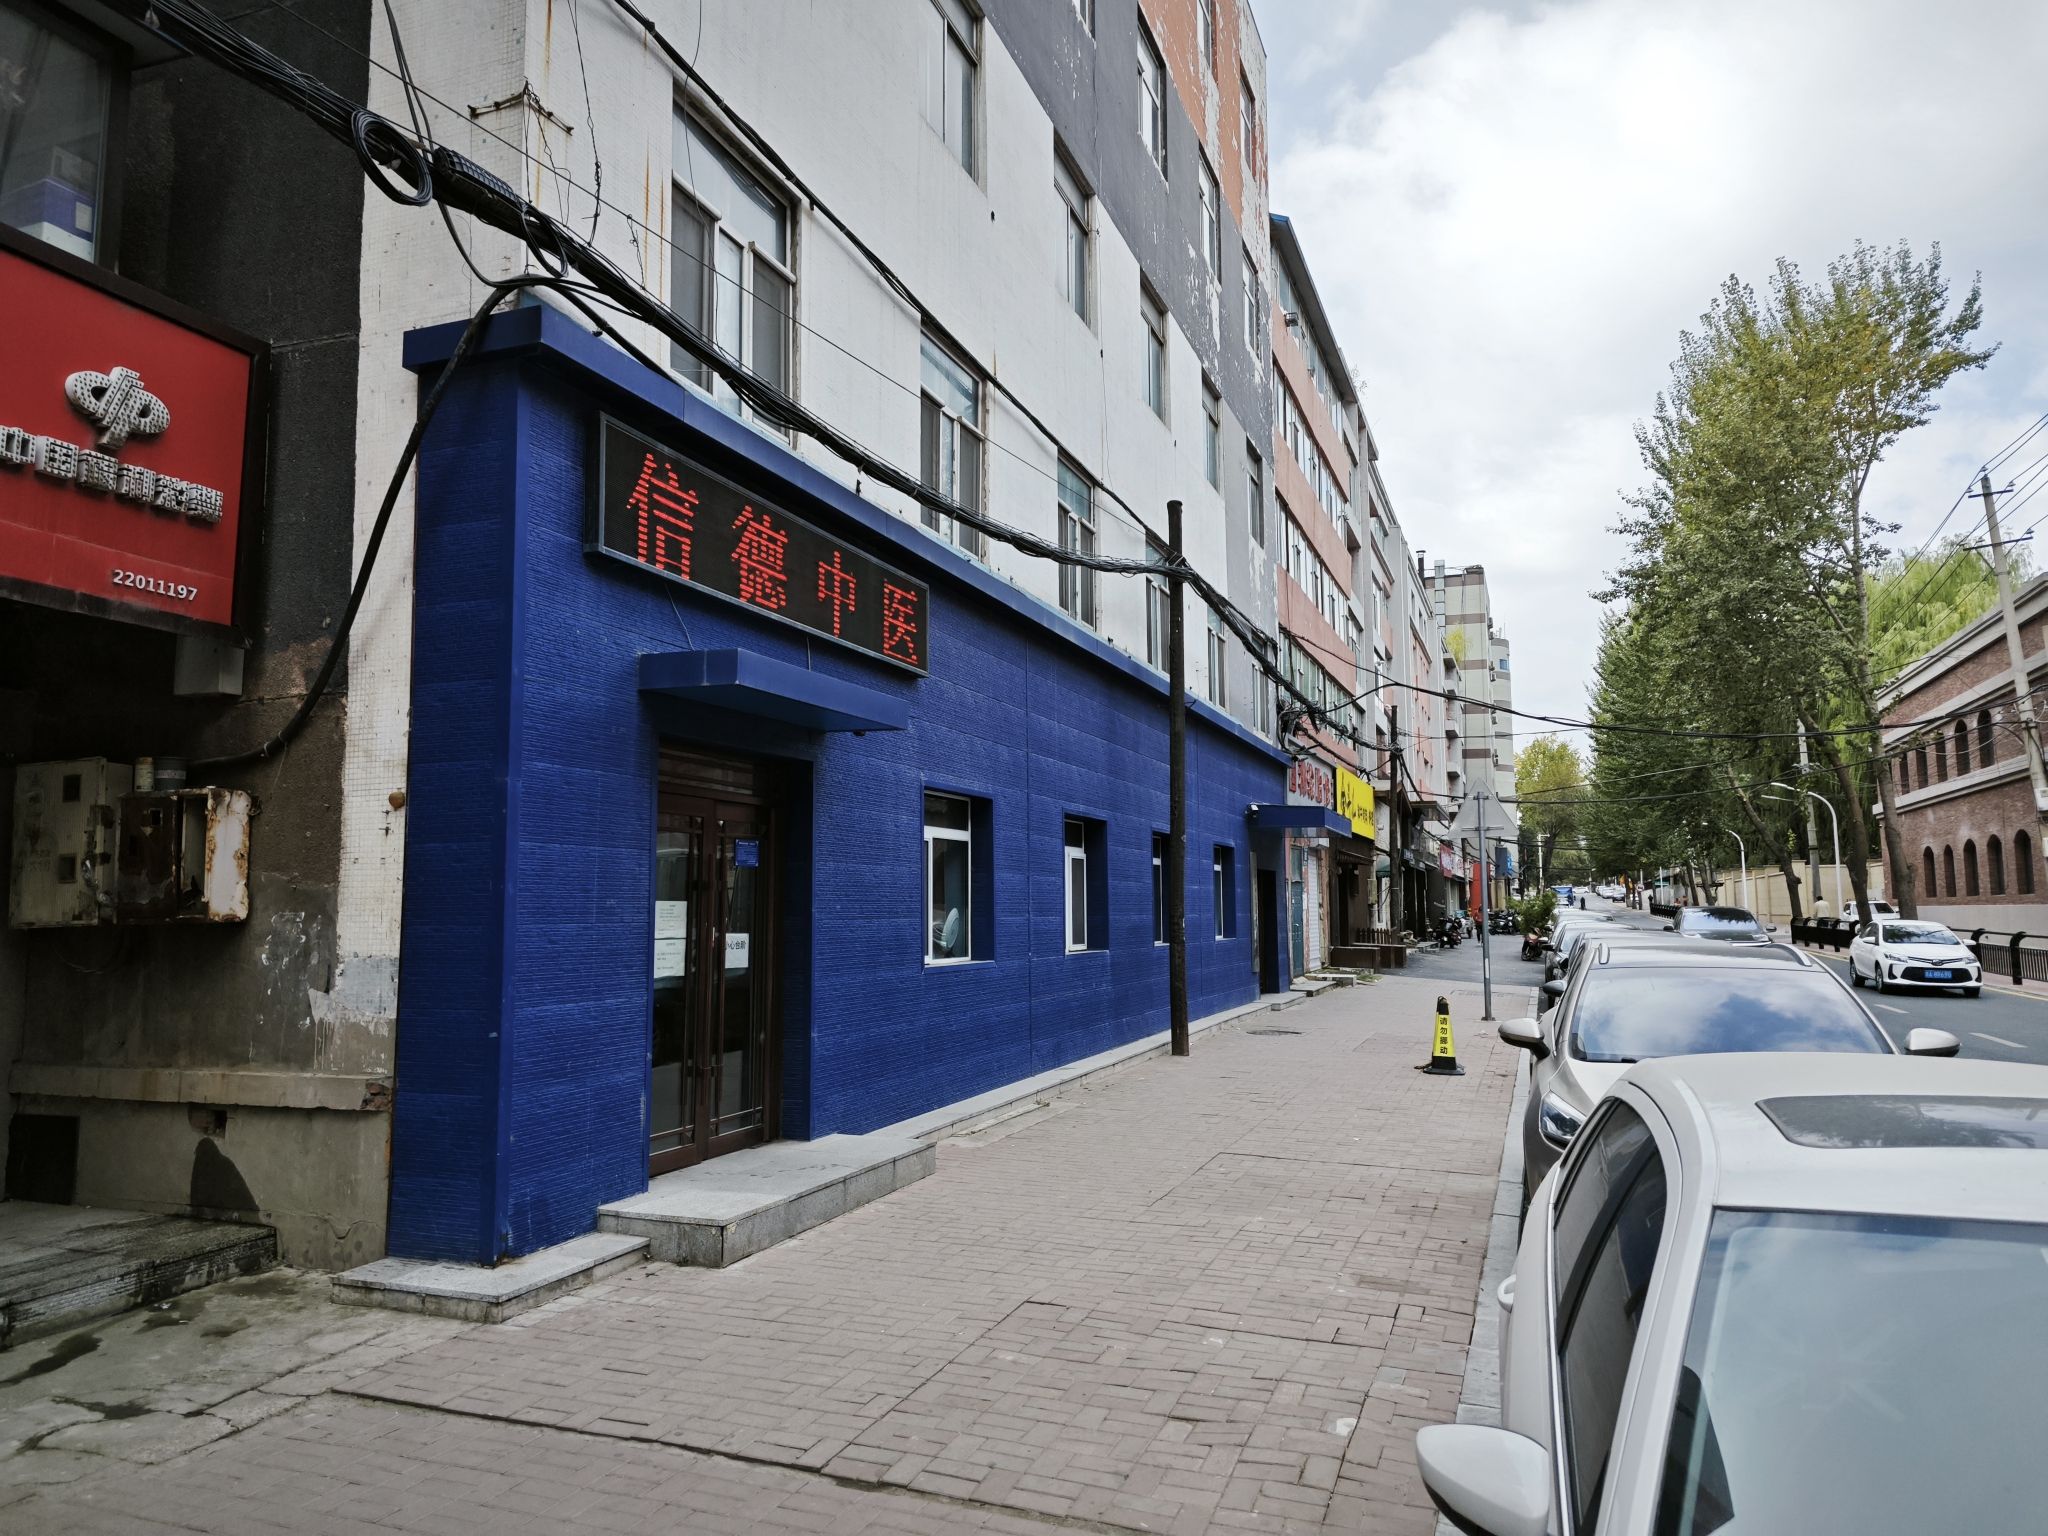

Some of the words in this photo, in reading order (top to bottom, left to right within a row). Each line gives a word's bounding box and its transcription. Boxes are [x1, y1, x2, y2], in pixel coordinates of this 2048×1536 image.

[113, 569, 198, 601] 22011197
[626, 453, 918, 665] 信德中医
